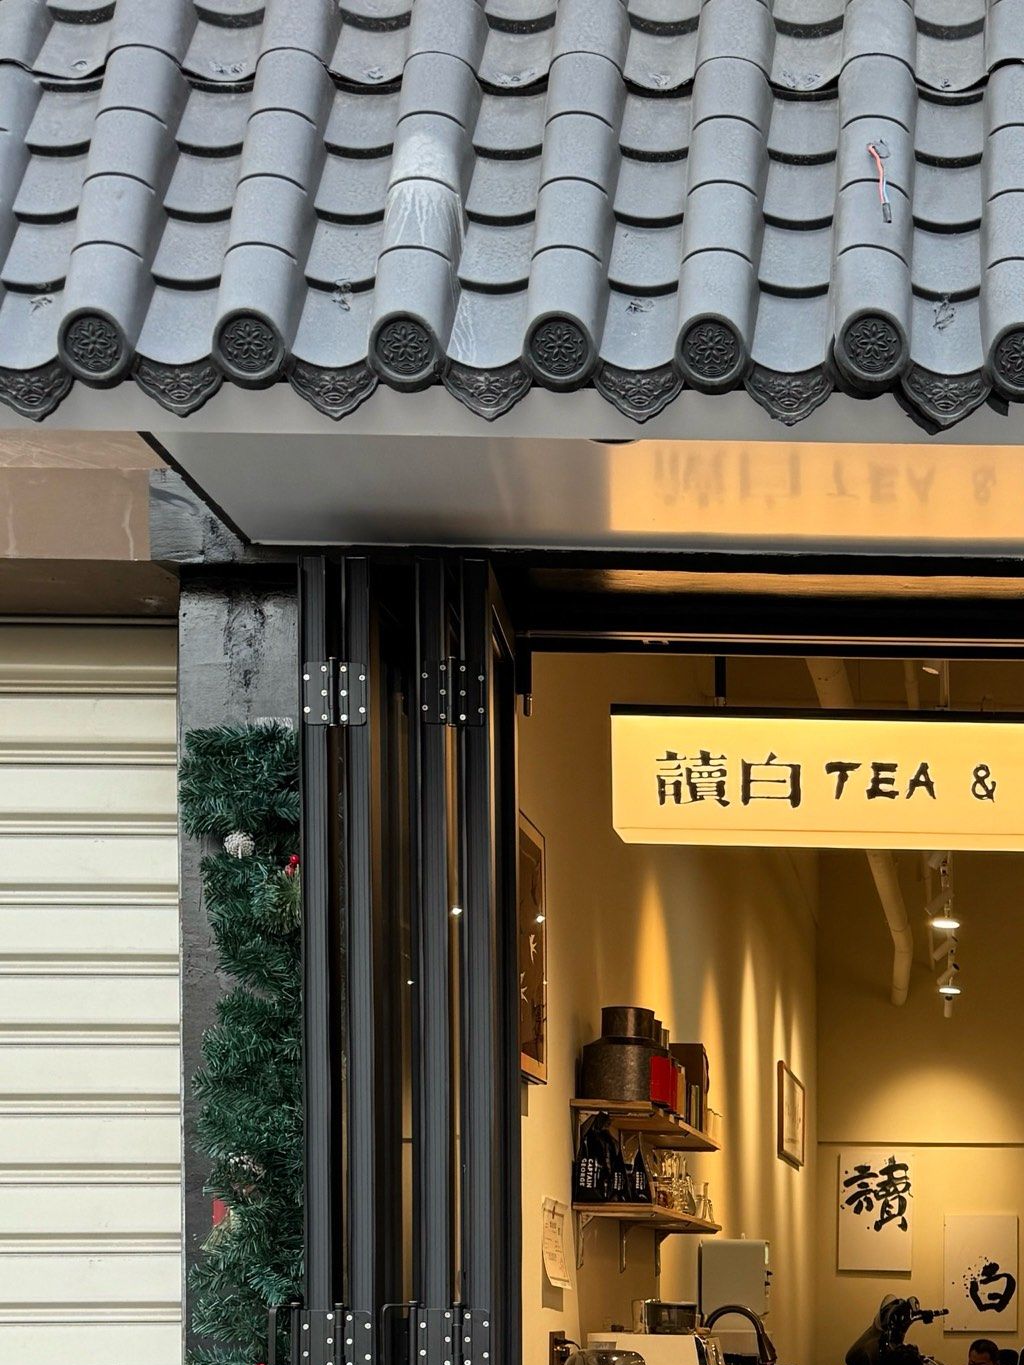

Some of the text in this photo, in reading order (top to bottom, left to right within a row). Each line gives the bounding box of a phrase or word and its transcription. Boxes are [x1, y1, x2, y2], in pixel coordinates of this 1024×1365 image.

[656, 751, 801, 808] 讀白
[826, 762, 936, 799] TEA
[972, 764, 996, 802] &
[579, 1158, 587, 1187] GEORGE
[586, 1158, 594, 1188] CAPTAIN
[843, 1156, 912, 1232] 讀
[969, 1262, 1016, 1312] 白
